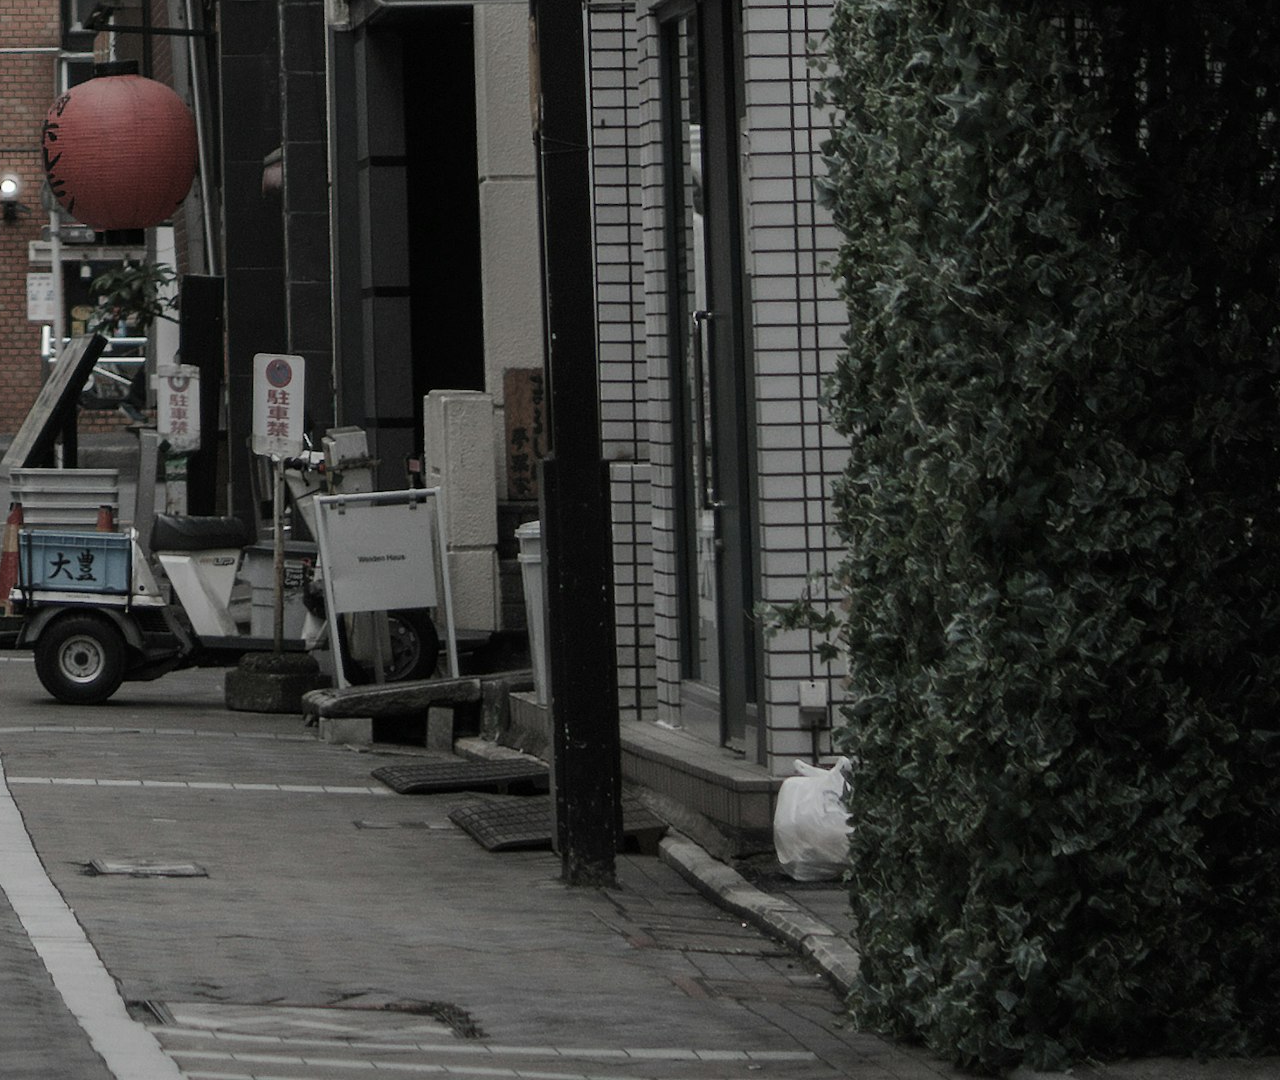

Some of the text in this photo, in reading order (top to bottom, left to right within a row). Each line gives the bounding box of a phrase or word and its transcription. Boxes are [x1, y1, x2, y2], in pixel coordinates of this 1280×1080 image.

[170, 394, 189, 436] 駐車禁
[267, 389, 290, 438] 駐車禁
